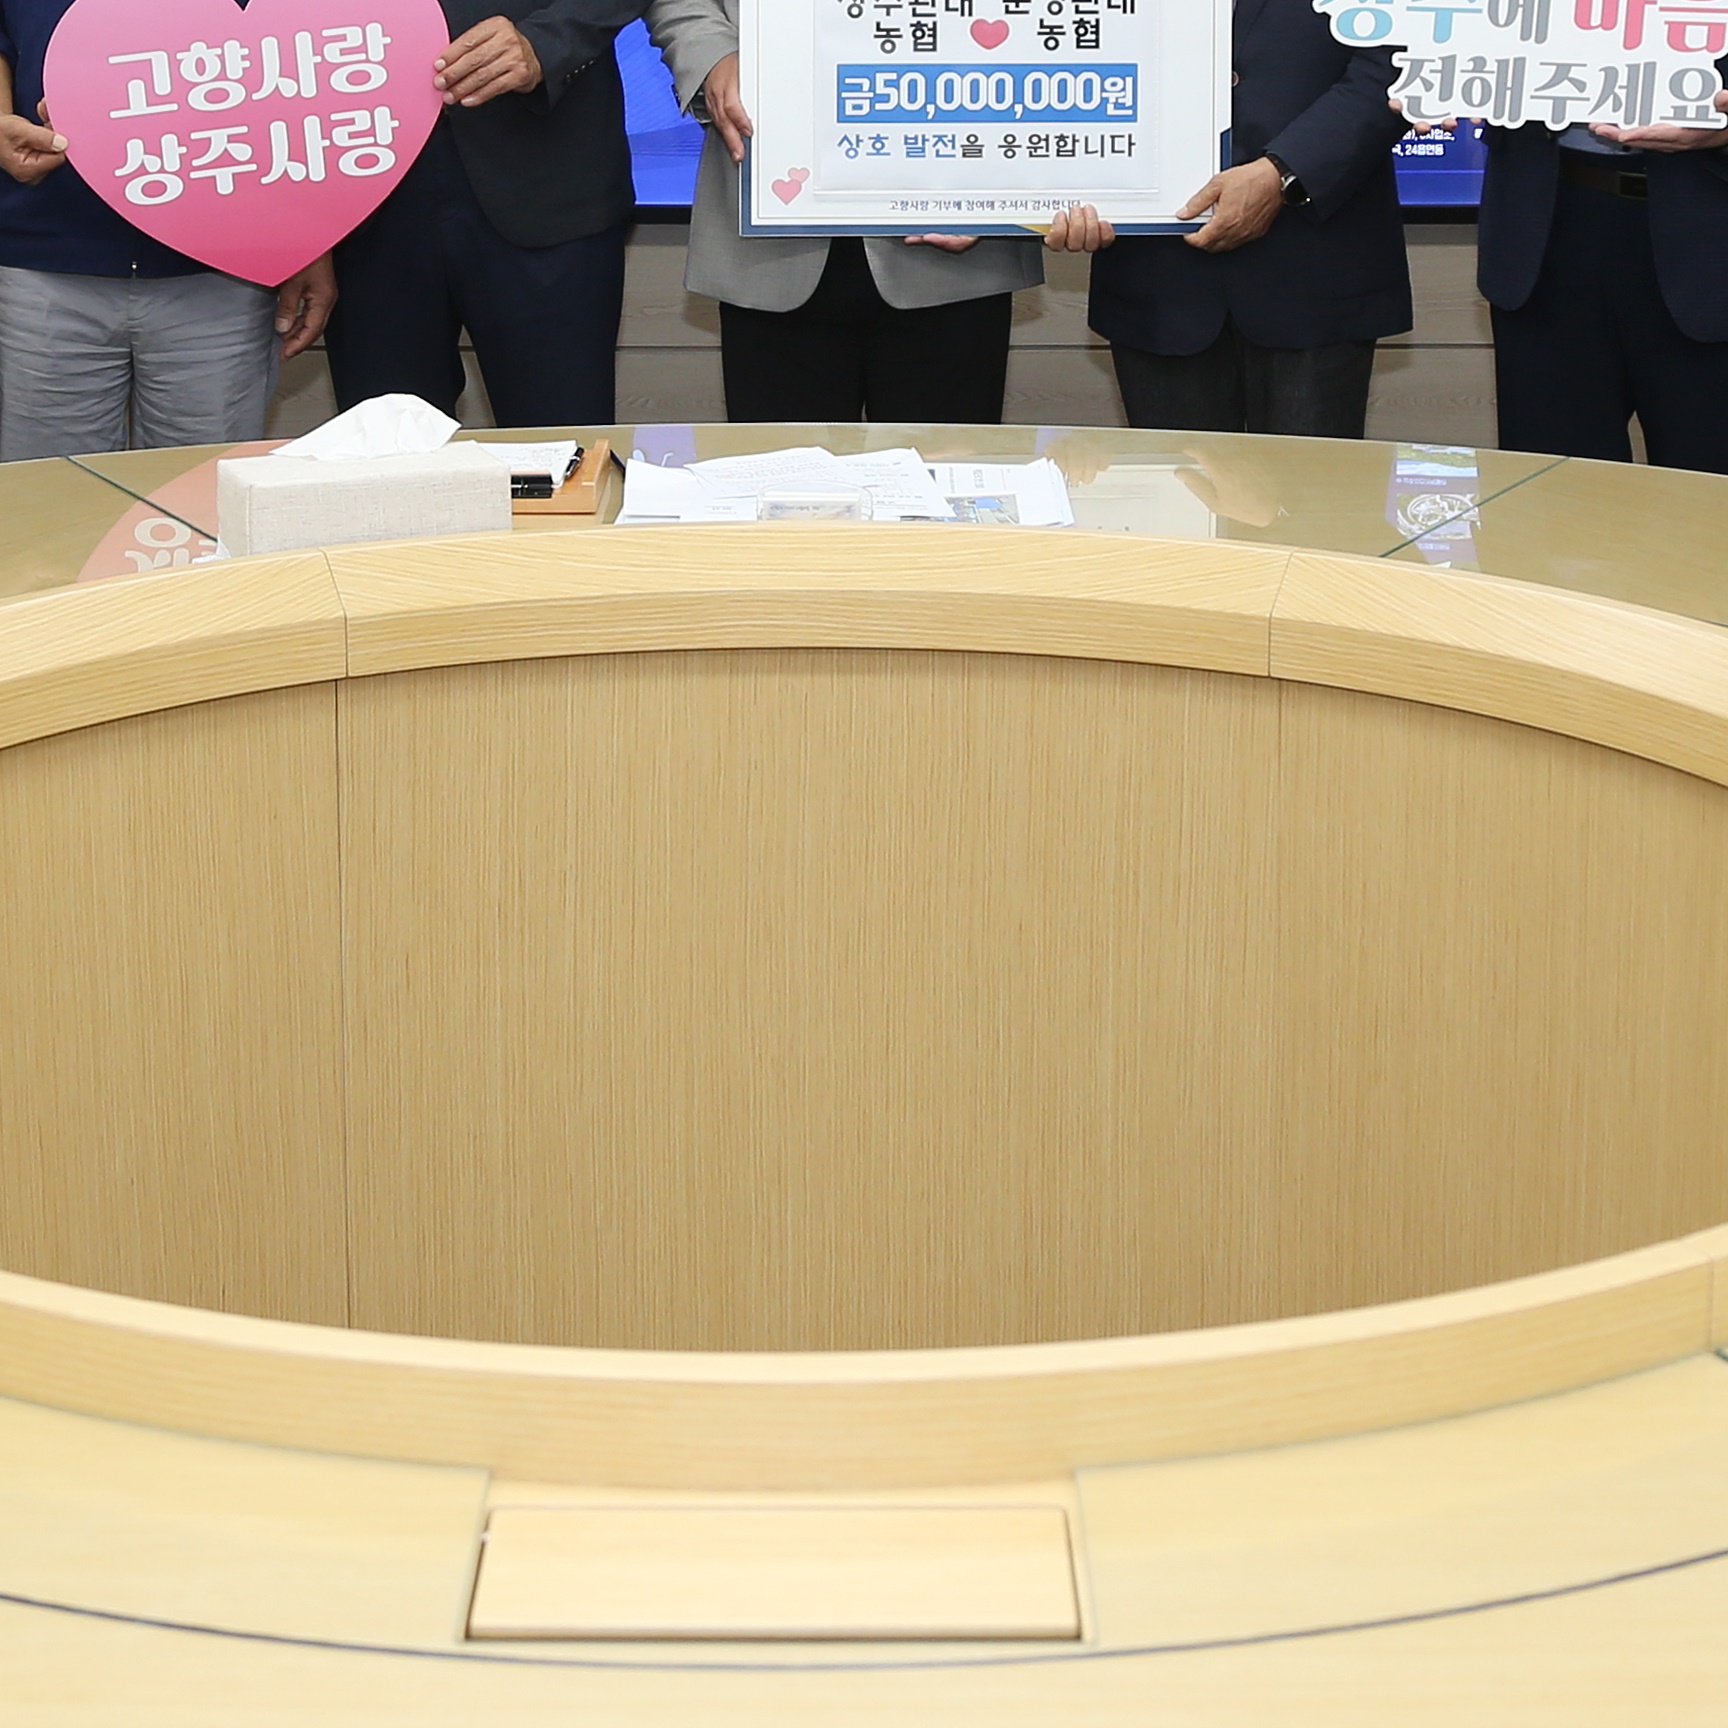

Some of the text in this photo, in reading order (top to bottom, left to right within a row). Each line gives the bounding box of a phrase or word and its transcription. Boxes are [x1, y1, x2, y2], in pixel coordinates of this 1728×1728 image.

[873, 17, 1101, 54] 농협 농협
[107, 22, 391, 119] 고향사랑
[839, 70, 1135, 120] 금50,000,000원
[1393, 55, 1725, 128] 전해주세요
[113, 106, 400, 206] 상주사랑
[836, 133, 1137, 159] 상호 발전을 응원합니다
[889, 200, 929, 211] 고향사랑
[932, 200, 962, 211] 기부에
[966, 200, 996, 211] 참여해
[998, 200, 1028, 211] 주셔서
